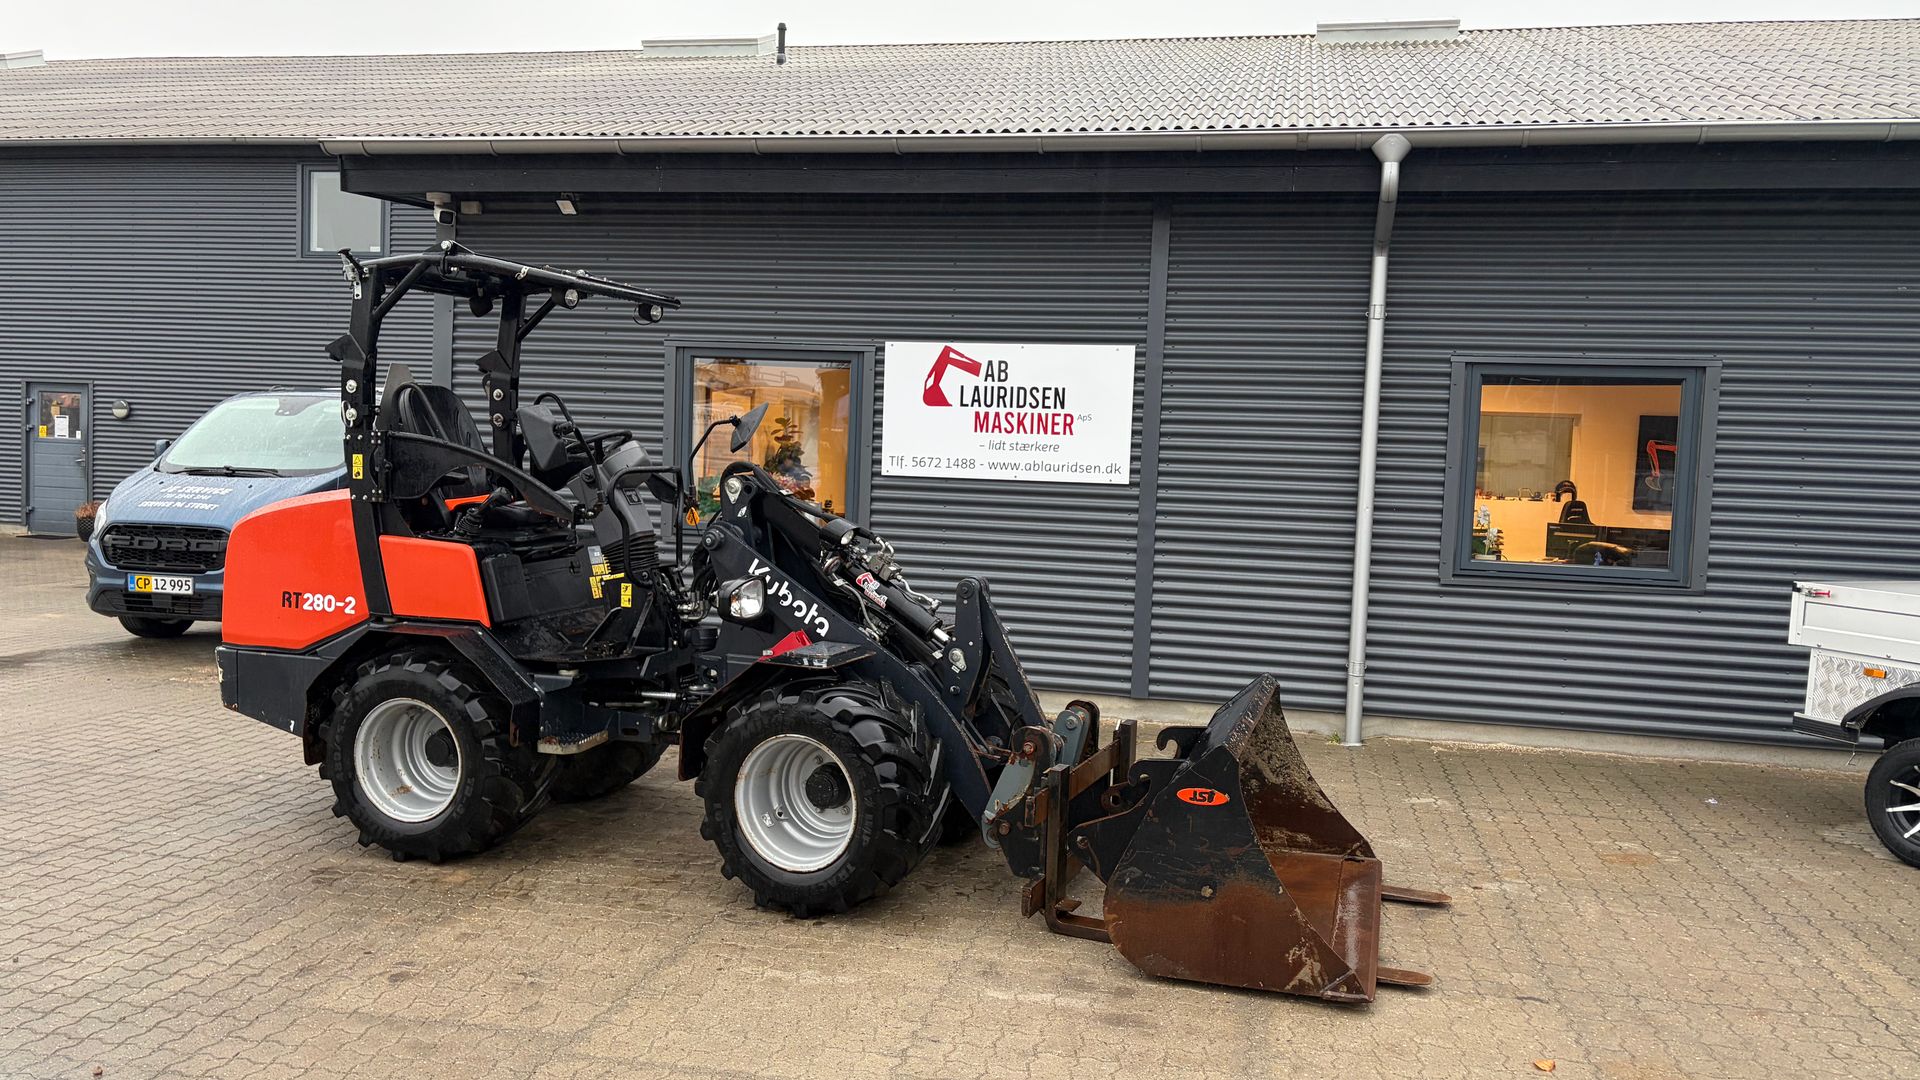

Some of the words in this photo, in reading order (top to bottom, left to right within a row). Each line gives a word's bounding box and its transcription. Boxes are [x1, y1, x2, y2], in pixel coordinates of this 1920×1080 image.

[983, 359, 1010, 383] AB
[959, 384, 1066, 410] LAURIDSEN
[973, 410, 1075, 436] MASKINER
[1076, 413, 1093, 422] ApS
[988, 440, 1006, 451] lidt
[1009, 441, 1060, 453] stærkere
[889, 455, 908, 470] Tlf.
[911, 456, 942, 469] 5672
[945, 457, 976, 470] 1488
[988, 460, 1122, 475] www.ablauridsen.dk
[136, 577, 151, 591] CP
[154, 578, 167, 591] 12
[169, 579, 191, 592] 995
[281, 590, 356, 615] RT280-2
[747, 558, 830, 637] Kubota
